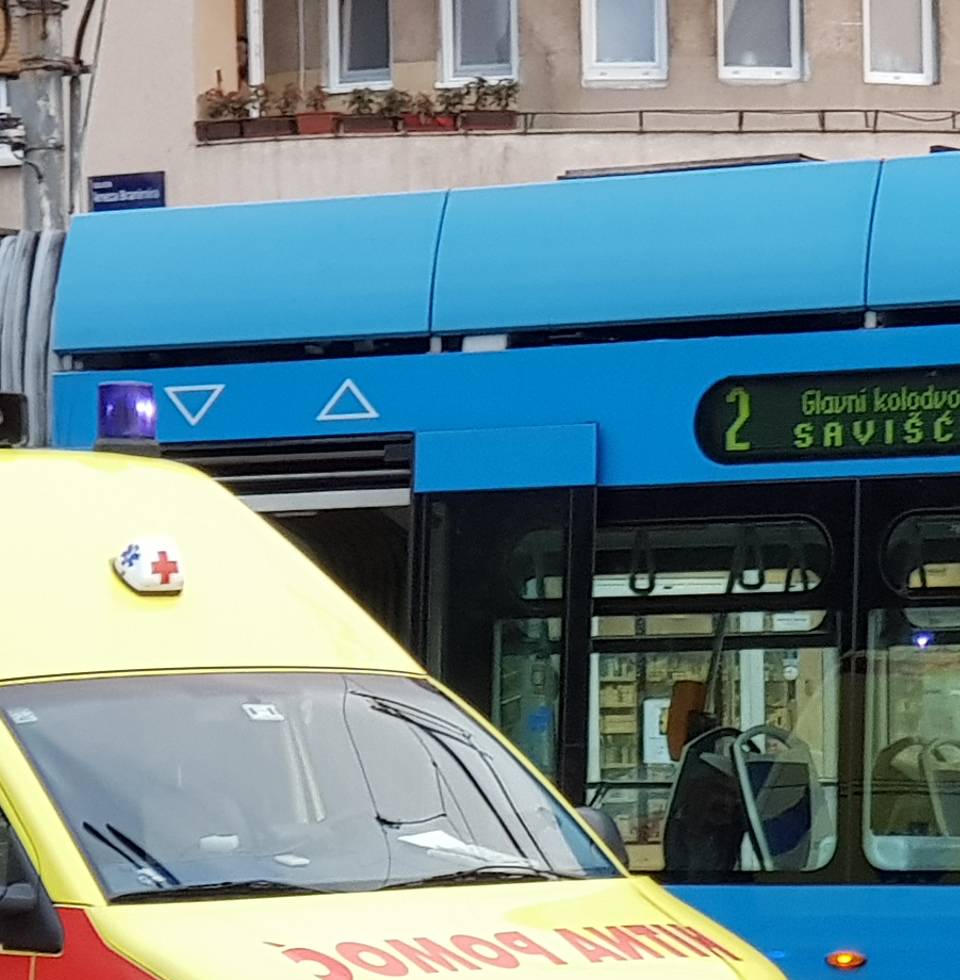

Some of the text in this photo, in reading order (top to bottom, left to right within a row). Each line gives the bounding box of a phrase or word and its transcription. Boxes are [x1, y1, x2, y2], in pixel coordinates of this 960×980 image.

[725, 387, 752, 452] 2
[802, 384, 960, 415] Glavni kolodvo
